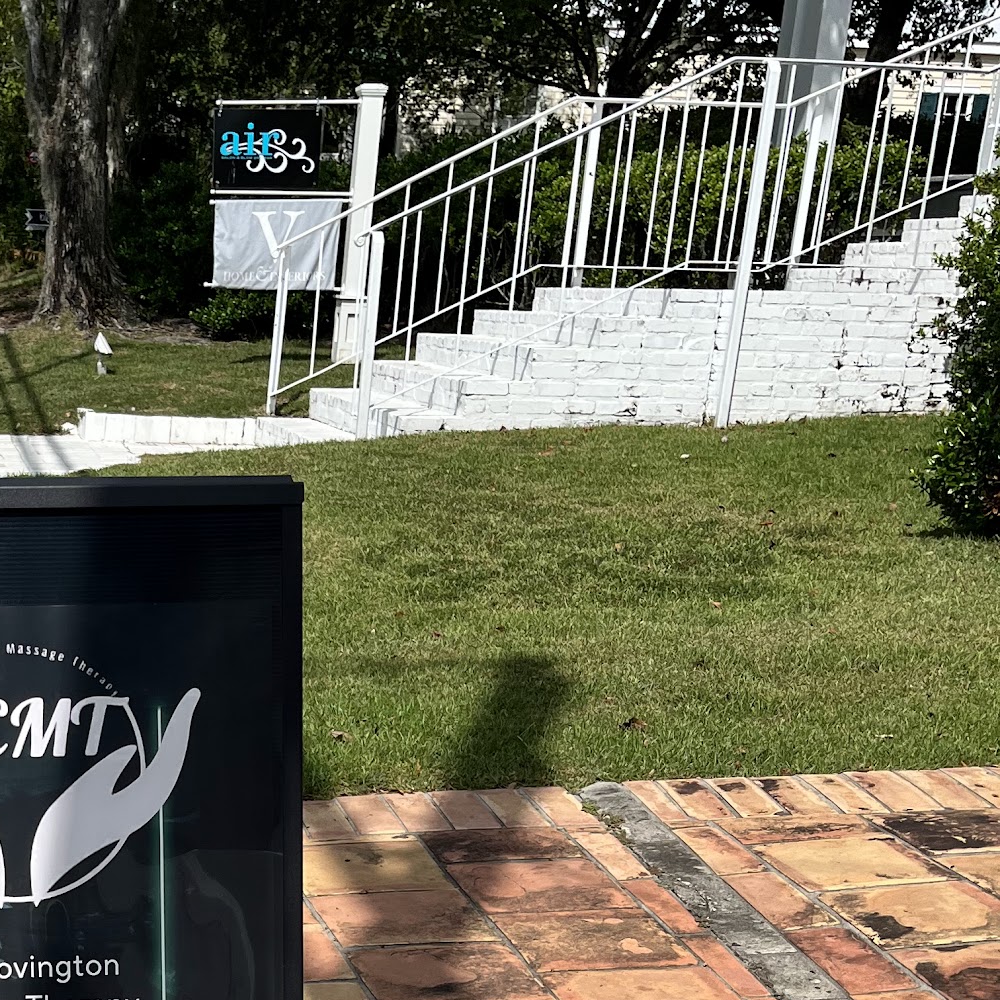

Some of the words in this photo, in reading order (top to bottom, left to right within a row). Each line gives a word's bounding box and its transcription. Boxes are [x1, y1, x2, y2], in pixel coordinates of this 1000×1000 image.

[219, 122, 280, 156] air
[269, 270, 326, 282] INERIORS
[6, 643, 65, 662] Massage
